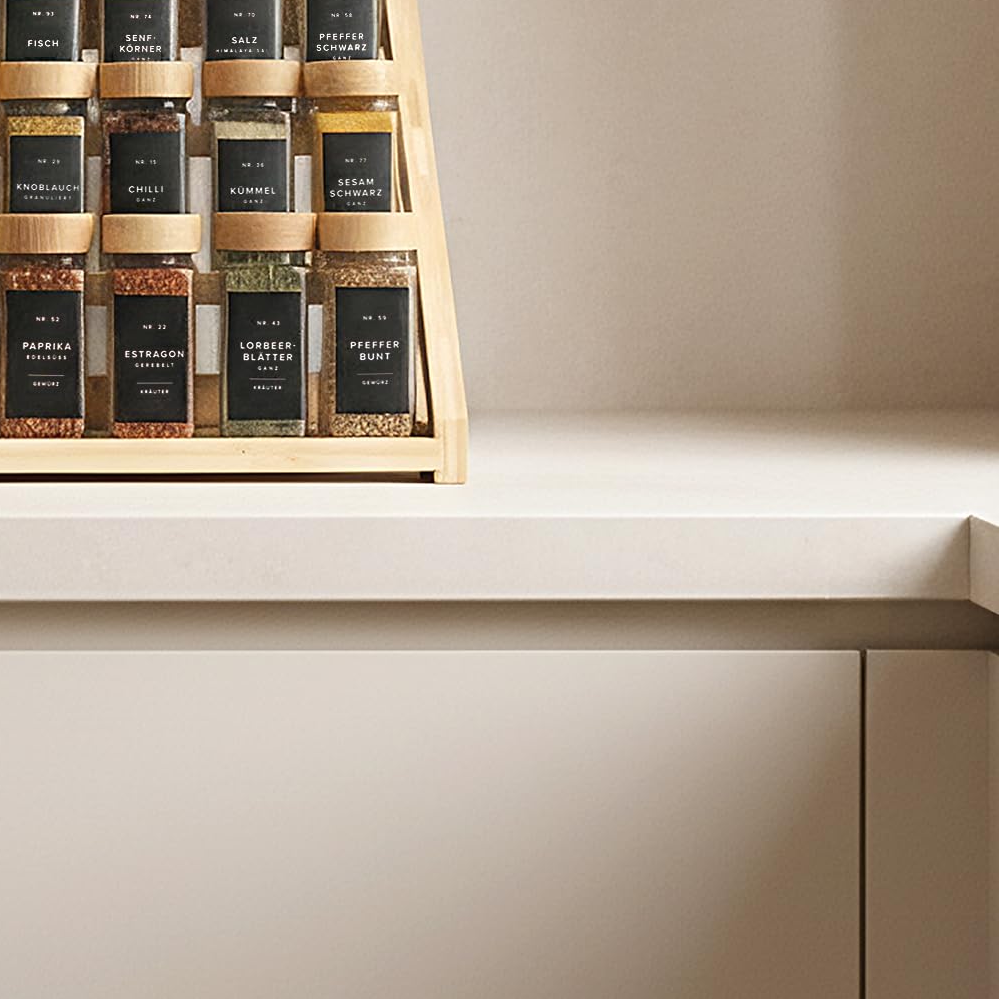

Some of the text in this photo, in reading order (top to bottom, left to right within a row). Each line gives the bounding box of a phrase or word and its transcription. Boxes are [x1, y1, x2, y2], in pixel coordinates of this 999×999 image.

[125, 34, 156, 42] SENF-
[231, 36, 258, 45] SALZ
[319, 32, 364, 41] PFEFFER
[27, 39, 59, 48] FISCH
[119, 43, 162, 53] KÖRNER
[316, 43, 367, 52] SCHWARZ
[337, 177, 374, 187] SESAM
[16, 183, 80, 192] KNOBLAUCH
[128, 185, 164, 194] CHILLI
[230, 185, 277, 195] KÜMMEL
[329, 188, 383, 198] SCHWARZ
[22, 341, 72, 351] PAPRIKA
[239, 341, 296, 350] LORBEER-
[349, 340, 400, 350] PFEFFER
[124, 350, 185, 359] ESTRAGON
[242, 352, 293, 362] BLÄTTER
[359, 352, 391, 361] BUNT
